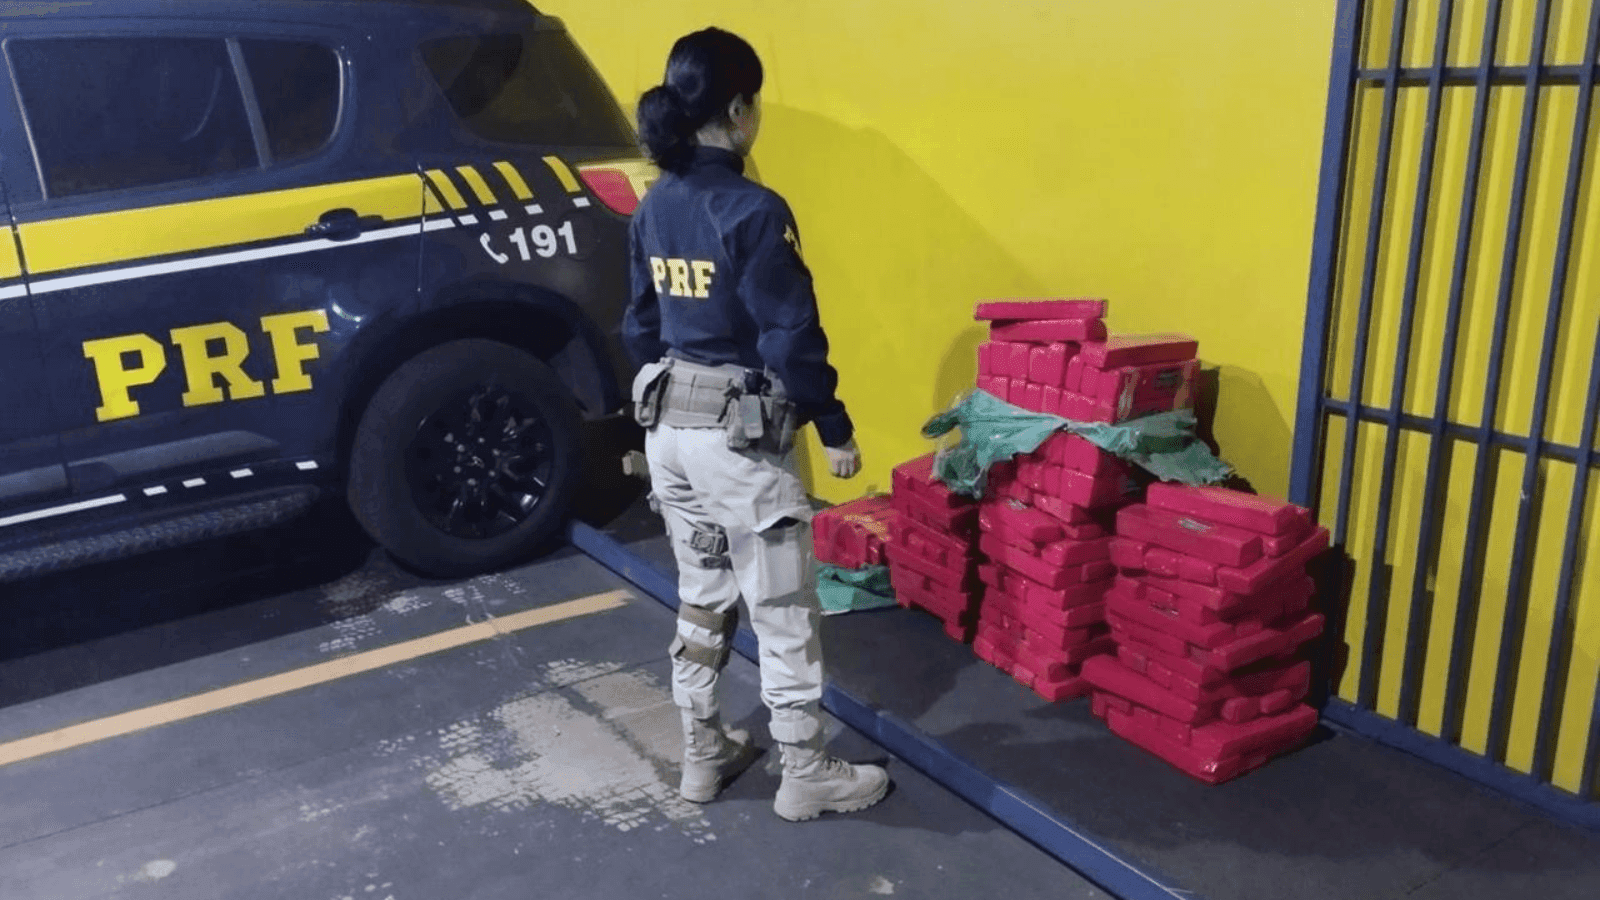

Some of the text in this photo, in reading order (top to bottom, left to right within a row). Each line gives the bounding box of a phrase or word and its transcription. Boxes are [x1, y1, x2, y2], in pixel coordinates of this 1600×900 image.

[508, 221, 578, 261] 191
[650, 257, 716, 299] PRF
[82, 308, 330, 422] PRF
